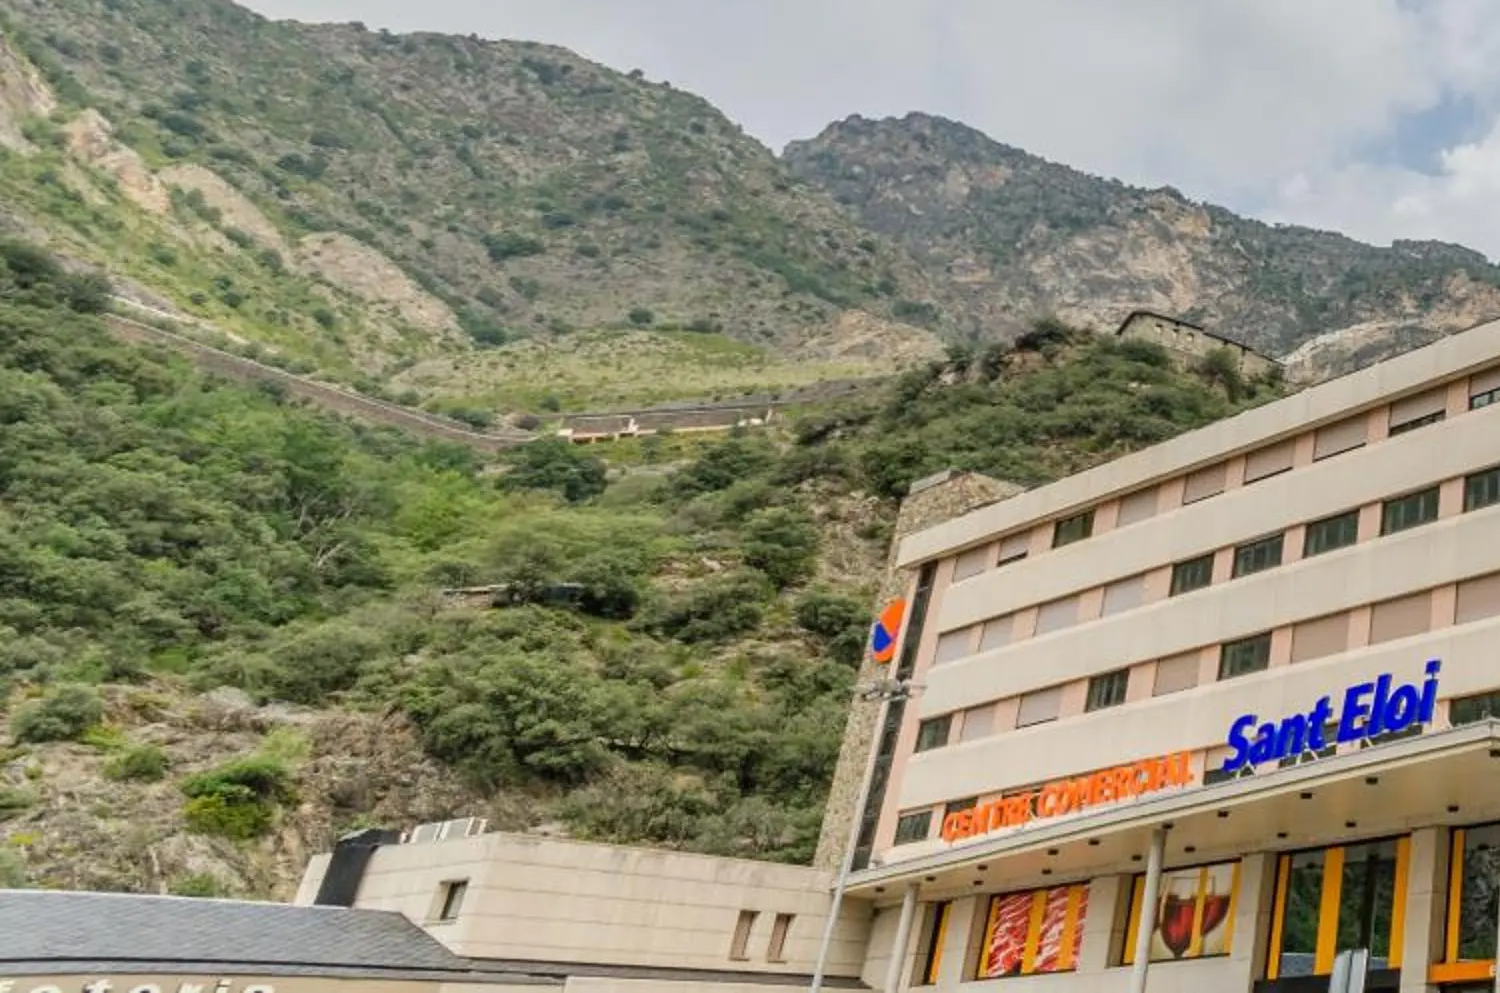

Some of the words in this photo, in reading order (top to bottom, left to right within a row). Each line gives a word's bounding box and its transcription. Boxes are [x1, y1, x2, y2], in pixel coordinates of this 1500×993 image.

[1222, 695, 1333, 772] Sant
[1336, 658, 1441, 743] Eloi
[943, 792, 1032, 842] CENTRE
[1037, 751, 1195, 818] COMERCIAL
